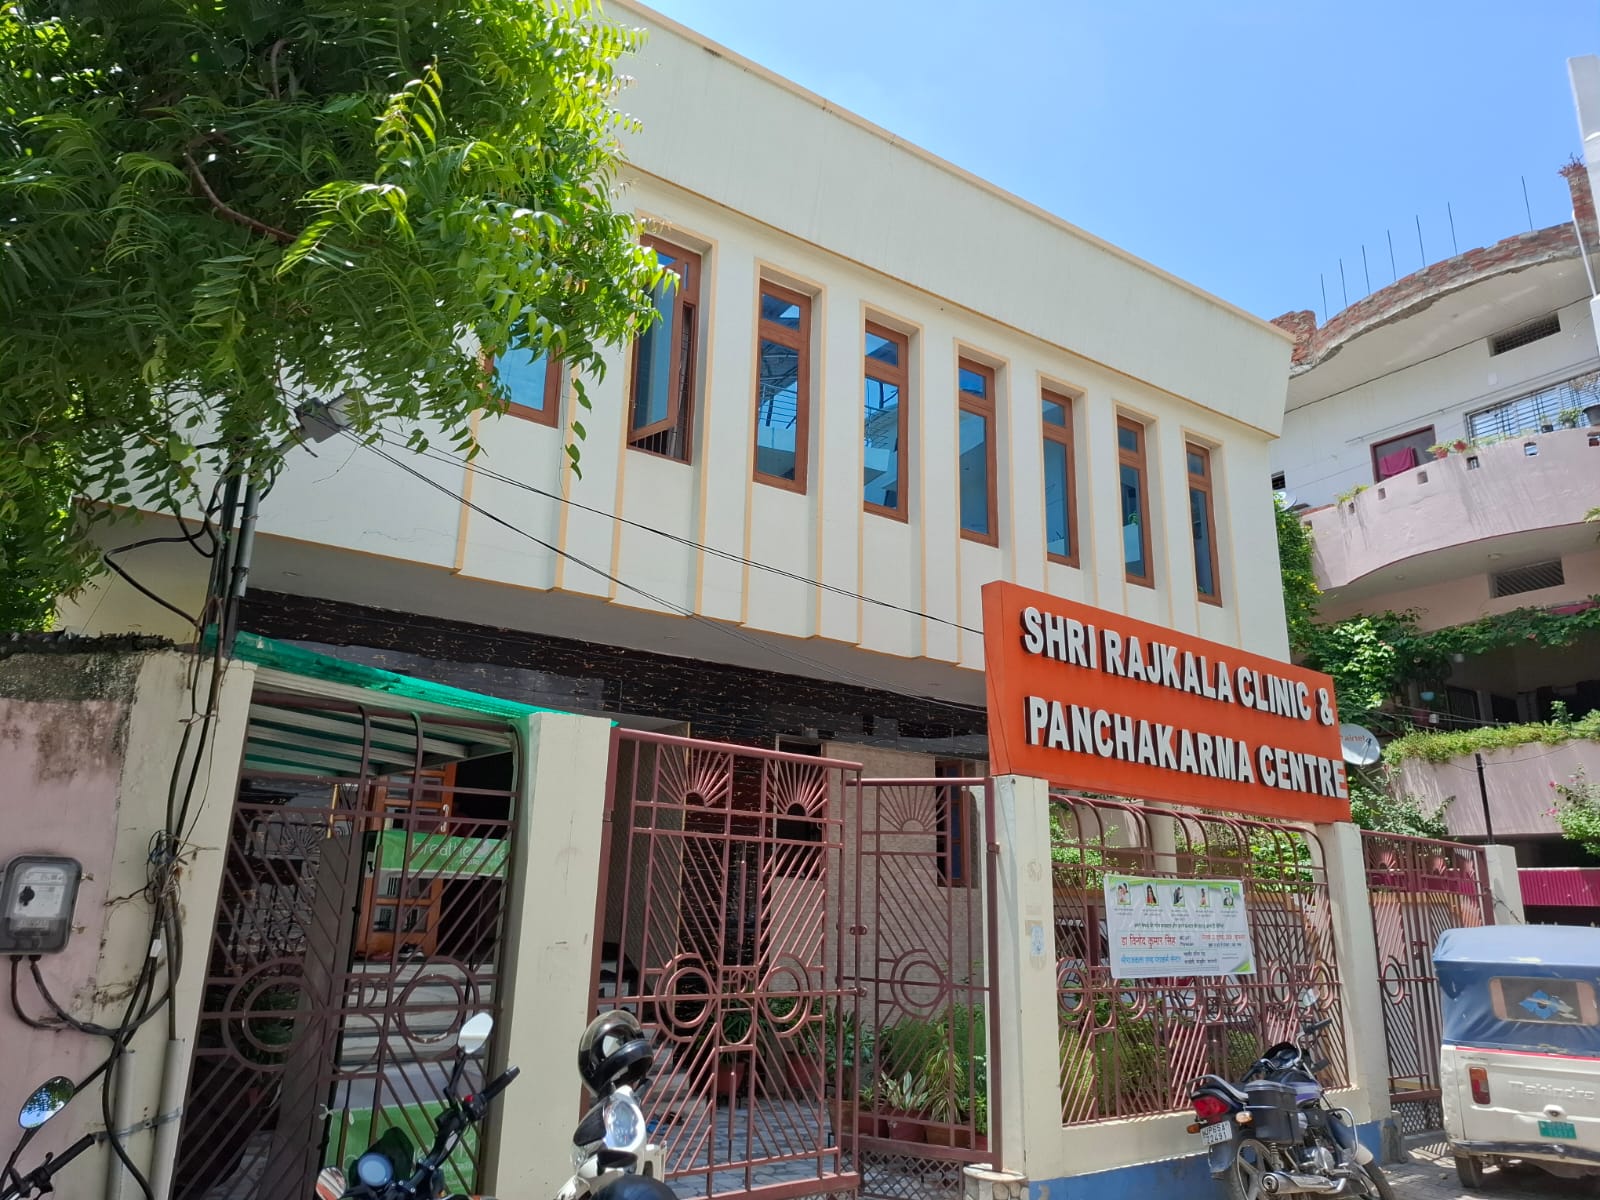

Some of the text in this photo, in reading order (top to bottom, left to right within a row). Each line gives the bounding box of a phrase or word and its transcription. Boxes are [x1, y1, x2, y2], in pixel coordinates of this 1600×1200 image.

[1021, 606, 1334, 726] SHRI RAJKALA CLINIC &
[1026, 696, 1348, 799] PANCHAKARMA CENTRE
